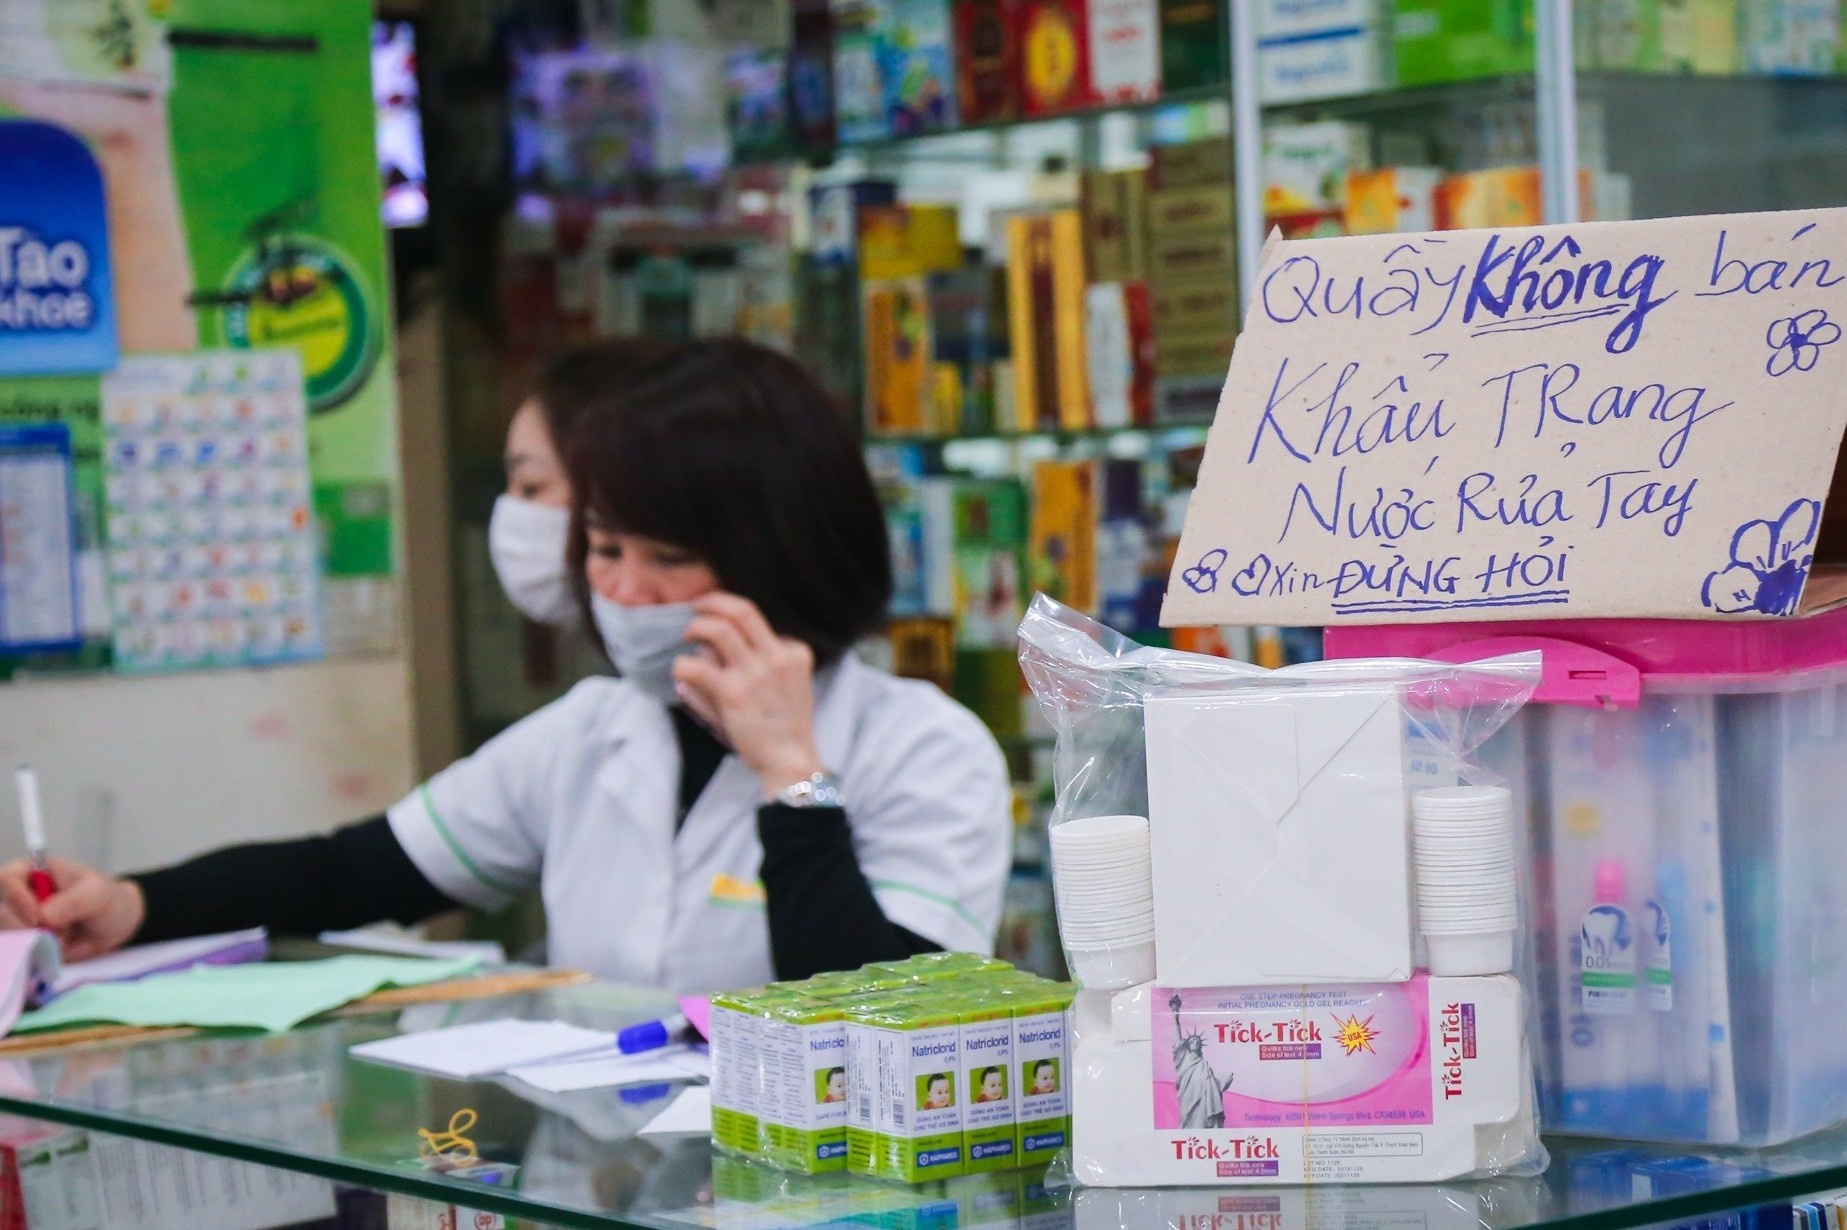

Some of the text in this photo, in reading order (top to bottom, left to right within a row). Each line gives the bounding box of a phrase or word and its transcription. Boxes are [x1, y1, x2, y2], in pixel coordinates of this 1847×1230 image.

[1463, 233, 1678, 354] Không
[1695, 223, 1845, 297] bán
[1247, 353, 1456, 464] Khẩu
[1278, 456, 1439, 544] Nước
[1586, 470, 1698, 537] Tay
[1474, 536, 1575, 592] HỎI
[1258, 992, 1277, 1000] STEP
[1279, 991, 1326, 1000] PREGNANCY
[1328, 990, 1347, 998] TEST
[1218, 1001, 1242, 1009] INITIAL
[1244, 1000, 1291, 1009] PREGNANCY
[1317, 1000, 1331, 1008] GEL
[1019, 1028, 1061, 1044] Natriclorid
[1214, 1019, 1322, 1043] Tick-Tick
[1347, 1032, 1362, 1042] USA
[810, 1037, 846, 1051] Natriclo
[912, 1042, 956, 1057] Natriclorid
[966, 1035, 1009, 1051] Natriclorid
[1440, 1003, 1462, 1100] Tick-Tick
[1409, 1110, 1425, 1119] USA
[1171, 1136, 1280, 1159] Tick-Tick
